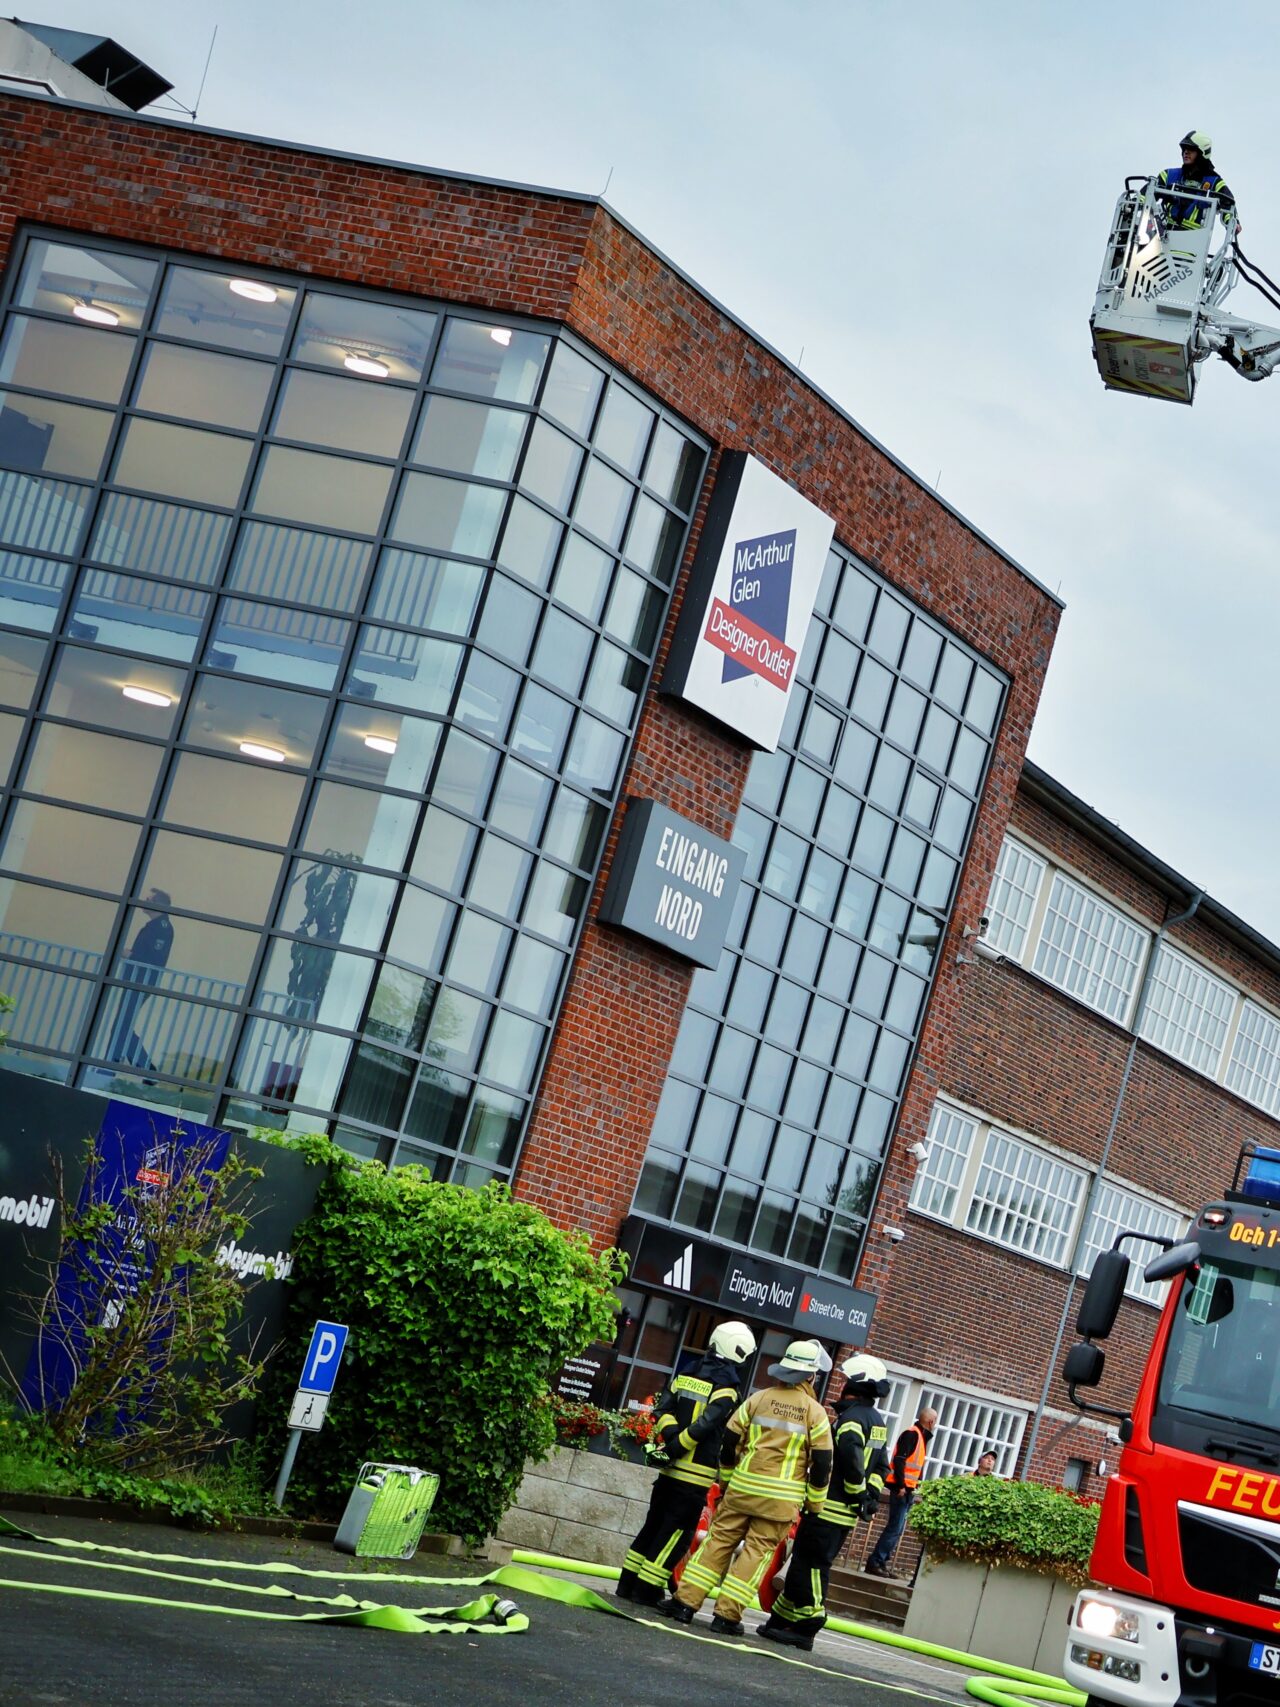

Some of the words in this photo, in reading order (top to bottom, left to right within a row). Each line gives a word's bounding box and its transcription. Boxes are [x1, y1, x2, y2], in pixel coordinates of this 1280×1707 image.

[1143, 267, 1193, 302] MAGIRUS
[735, 540, 793, 574] McArthur
[732, 577, 760, 603] Glen
[710, 607, 759, 656] Designer
[758, 639, 791, 680] Outlet
[656, 827, 728, 898] EINGANG
[655, 884, 703, 941] NORD
[1229, 1222, 1265, 1246] Och
[728, 1269, 768, 1307] Eingang
[769, 1281, 796, 1308] Nord
[848, 1310, 867, 1328] CECIL
[309, 1332, 337, 1381] P
[773, 1407, 804, 1421] Ochtrup
